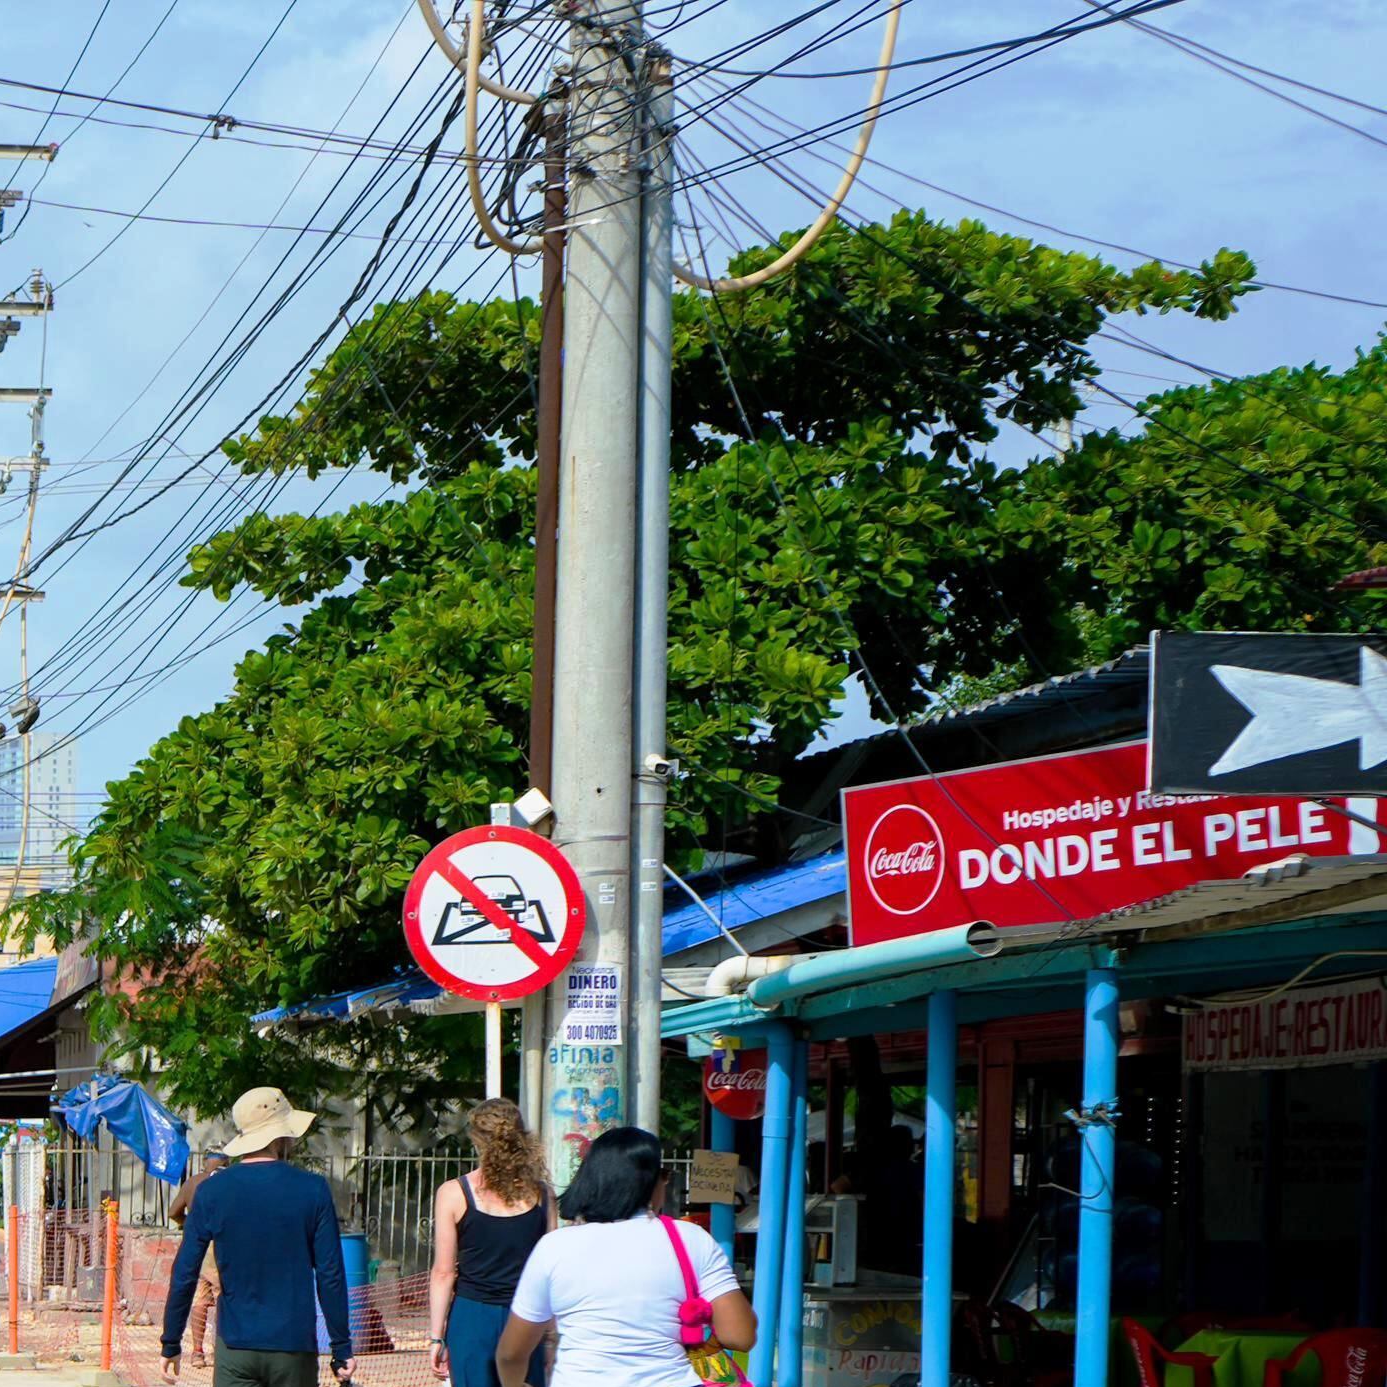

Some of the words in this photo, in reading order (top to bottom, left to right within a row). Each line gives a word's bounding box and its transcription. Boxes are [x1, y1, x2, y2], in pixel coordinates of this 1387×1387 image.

[1003, 799, 1113, 831] Hospedaje
[1117, 796, 1132, 817] y
[959, 828, 1121, 890] DONDE
[1132, 820, 1193, 867] EL
[1204, 799, 1332, 857] PELE
[870, 840, 938, 878] Coca-Cola
[568, 975, 617, 990] DINERO
[567, 1025, 583, 1040] 300
[549, 1043, 614, 1064] afinia
